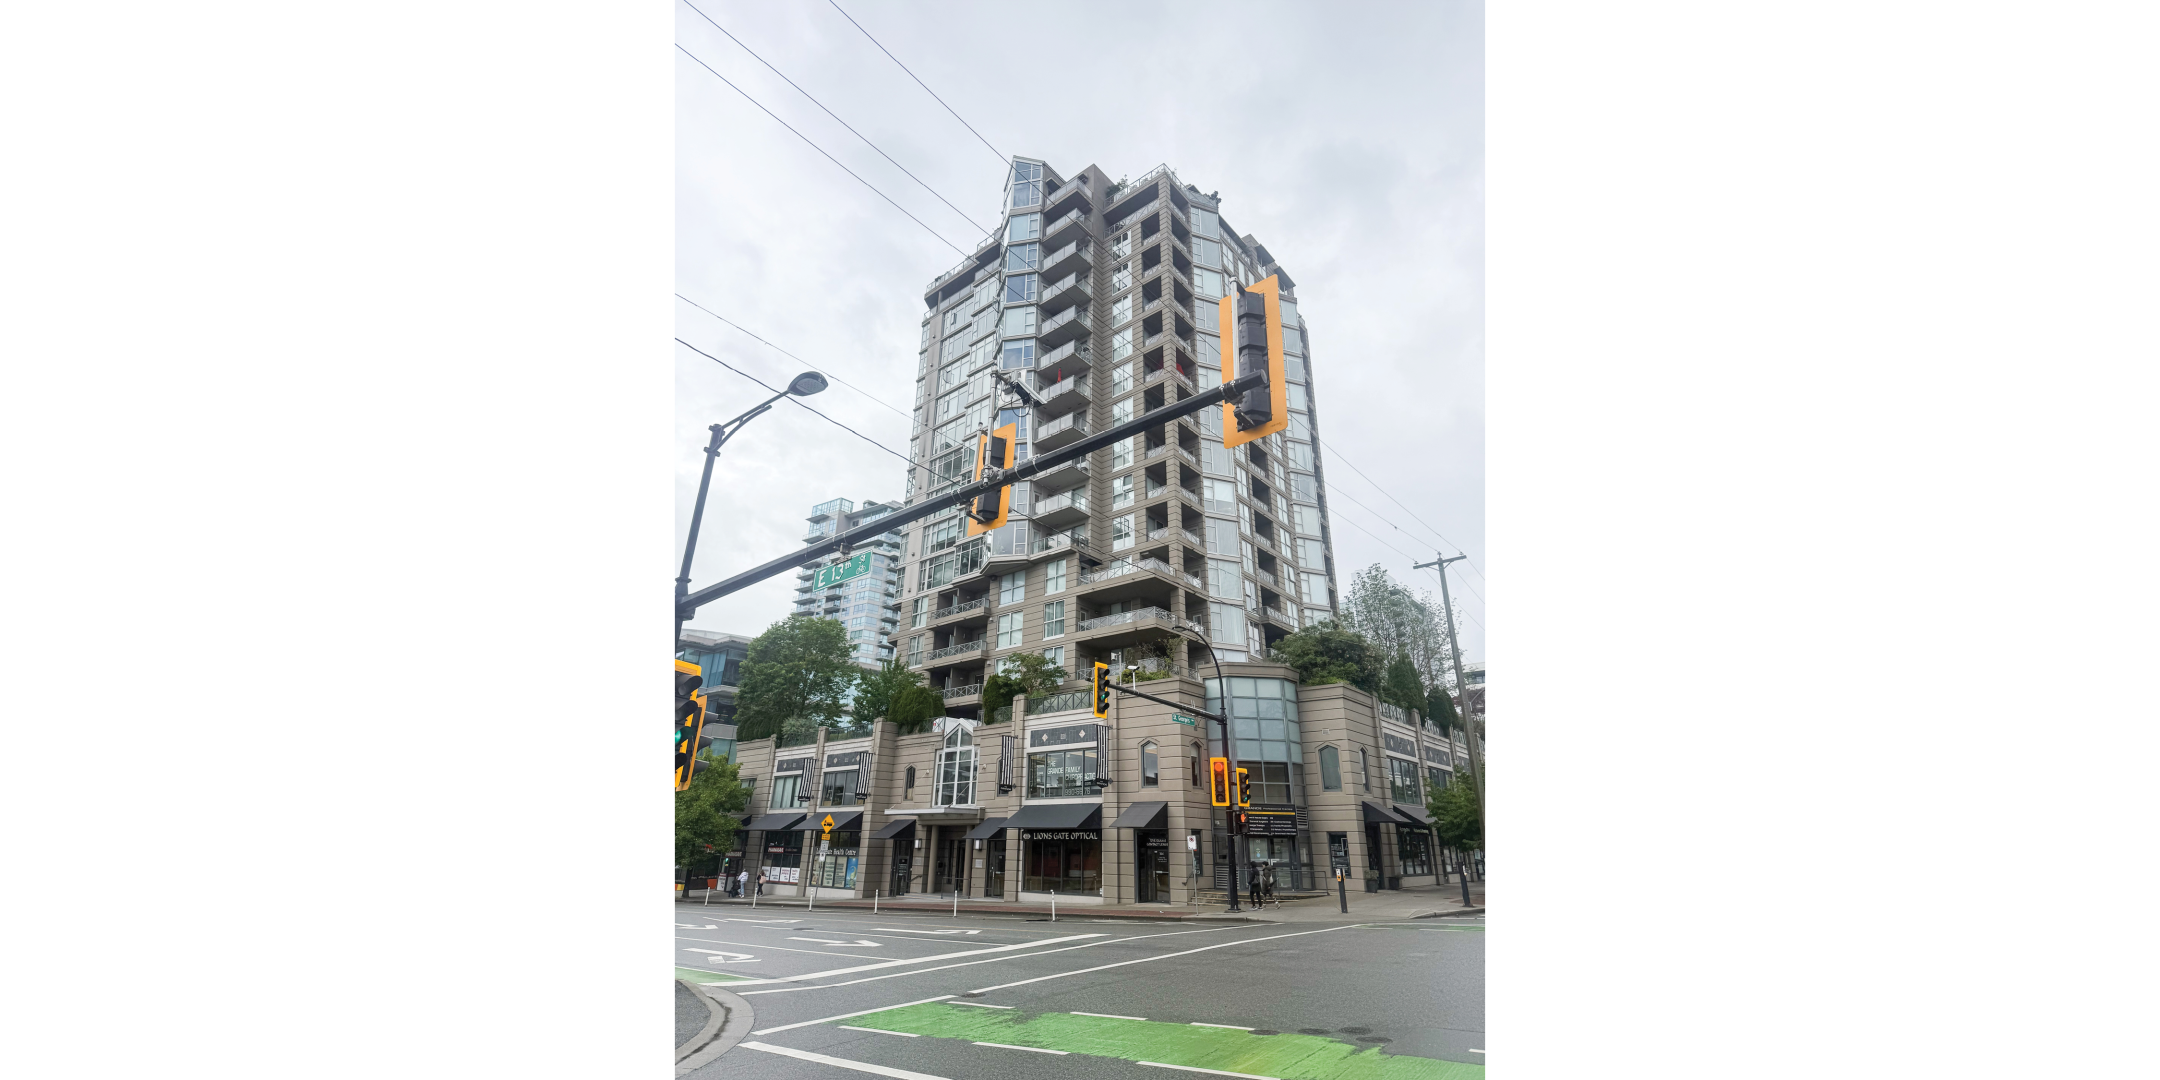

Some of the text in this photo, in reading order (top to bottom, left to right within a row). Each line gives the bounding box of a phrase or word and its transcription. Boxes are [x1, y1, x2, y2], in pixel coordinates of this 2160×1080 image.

[817, 569, 827, 587] E
[831, 562, 851, 582] 13th
[1033, 832, 1098, 840] LIONS GATE OPTICAL
